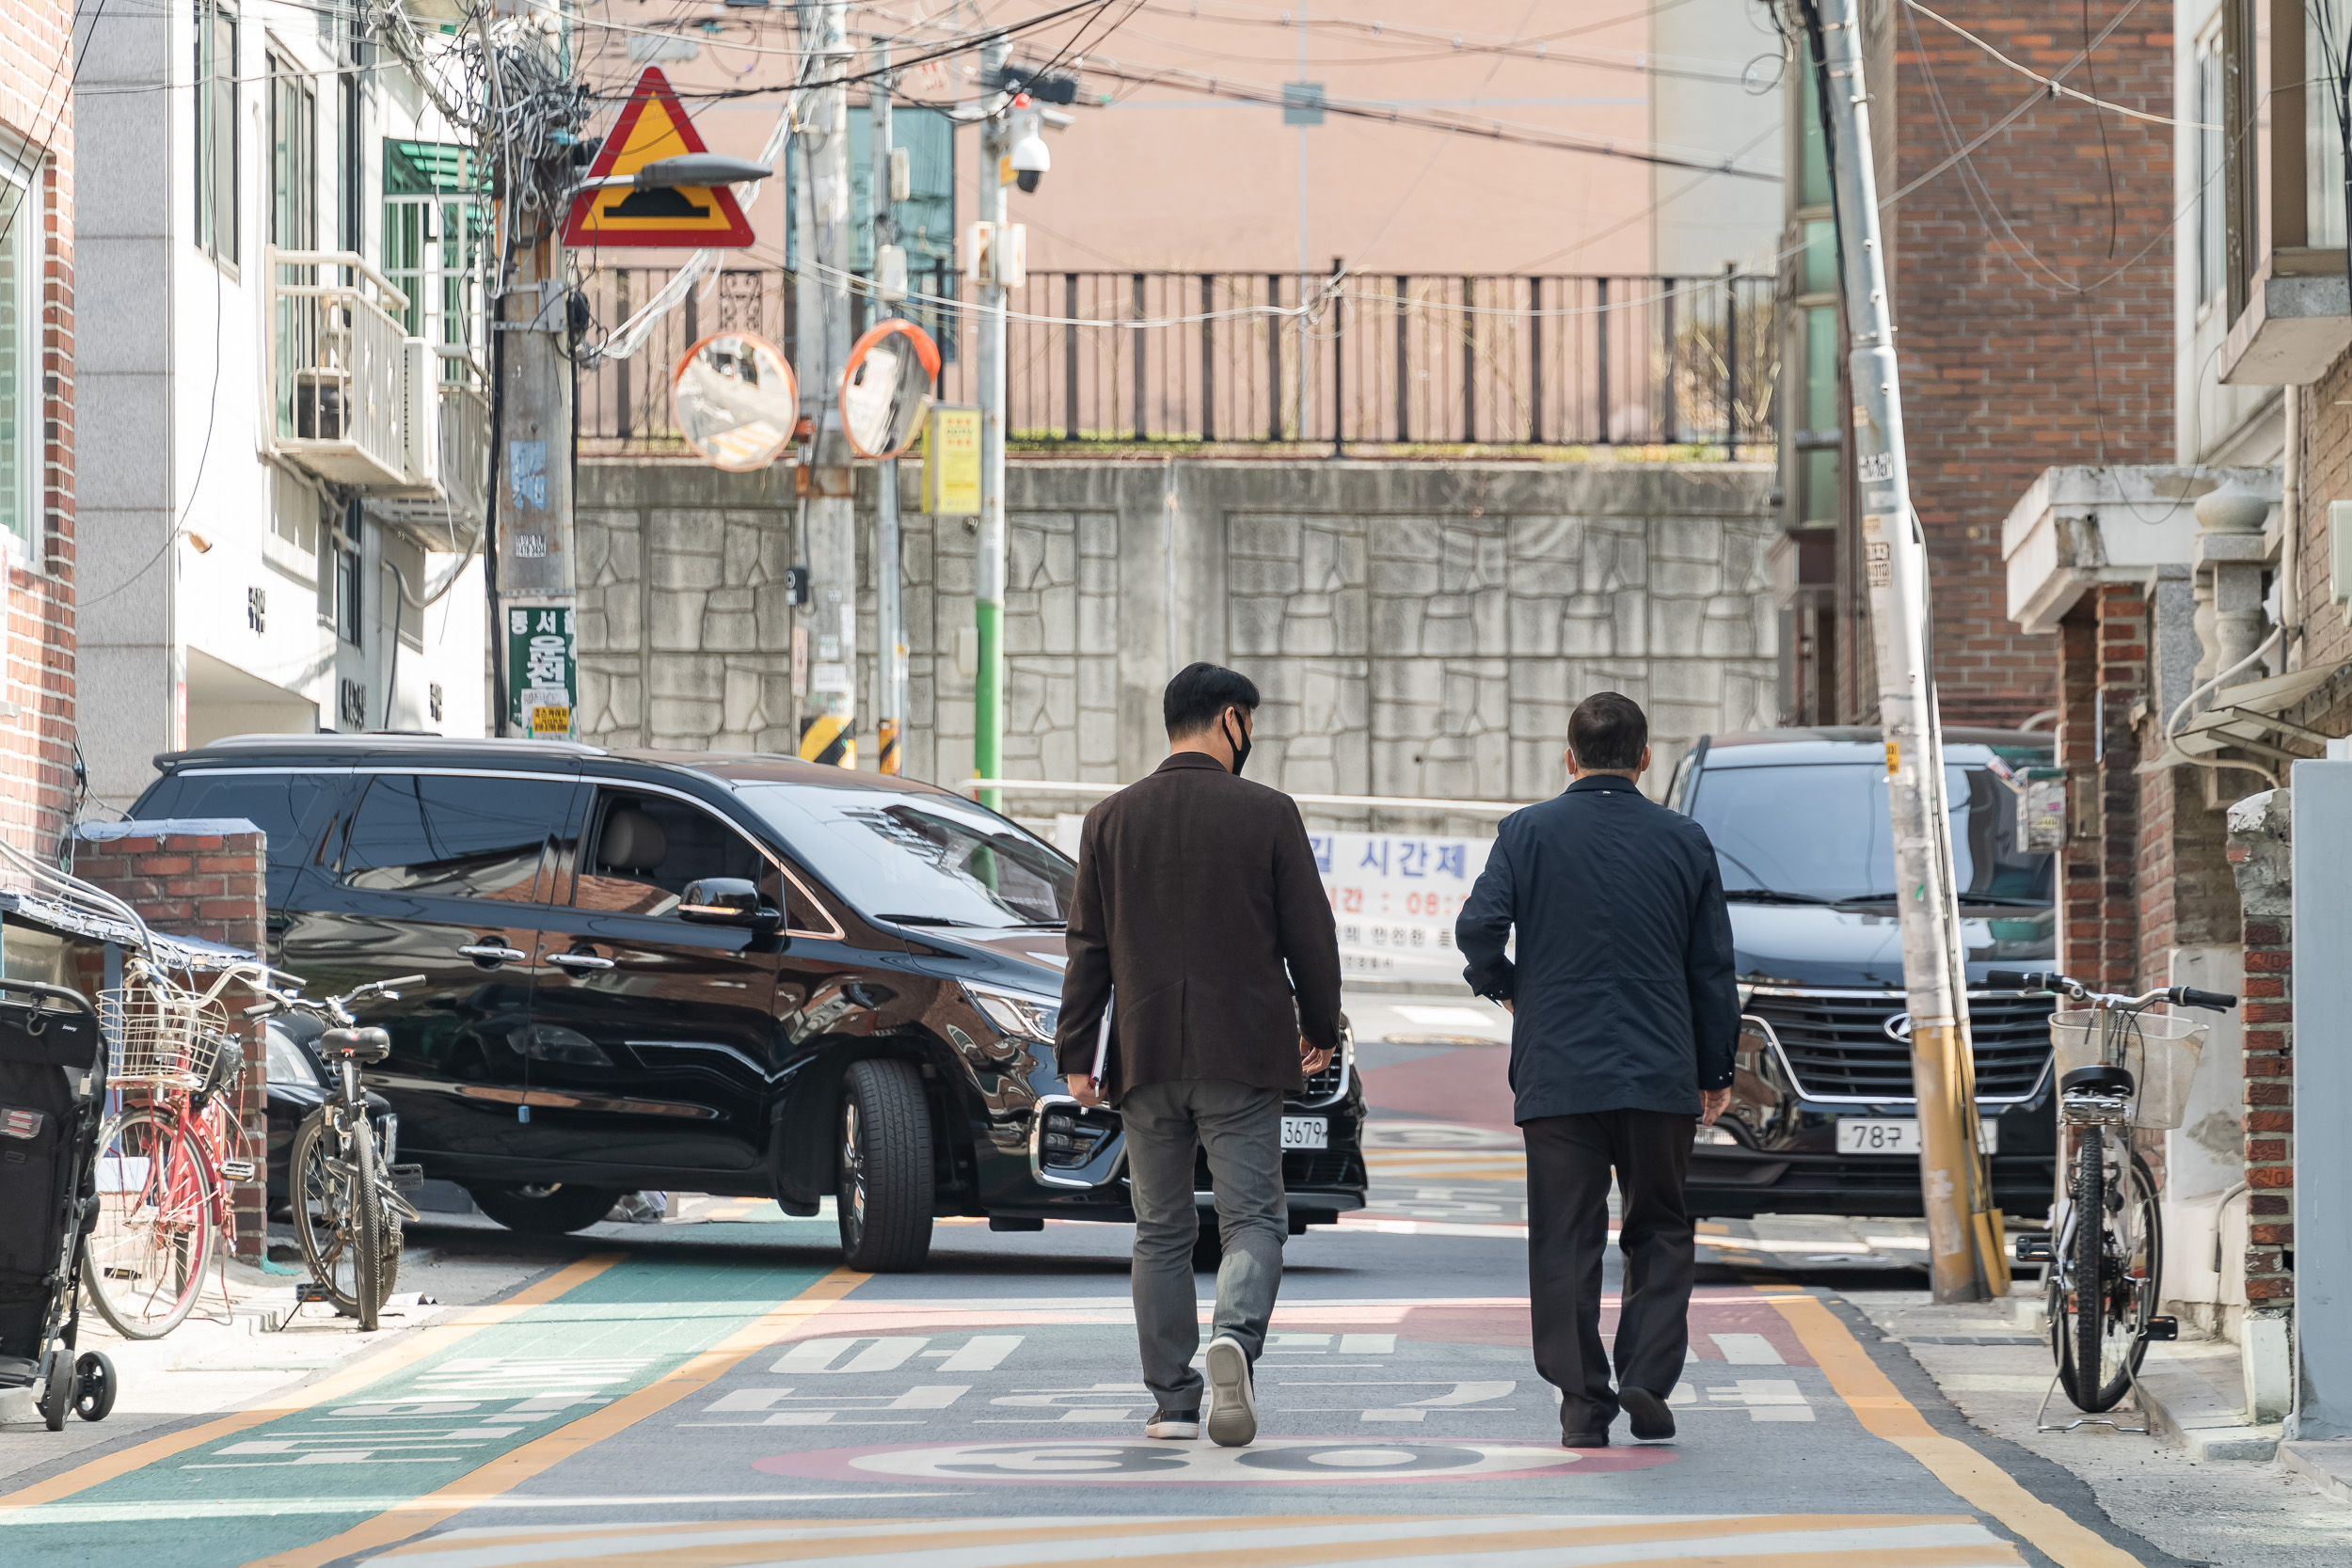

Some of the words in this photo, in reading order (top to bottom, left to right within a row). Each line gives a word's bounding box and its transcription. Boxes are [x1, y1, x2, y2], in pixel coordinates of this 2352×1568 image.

[1360, 839, 1467, 879] 시간제
[1284, 1121, 1323, 1145] 3679
[1852, 1125, 1902, 1148] 78구
[933, 1444, 1486, 1474] 30
